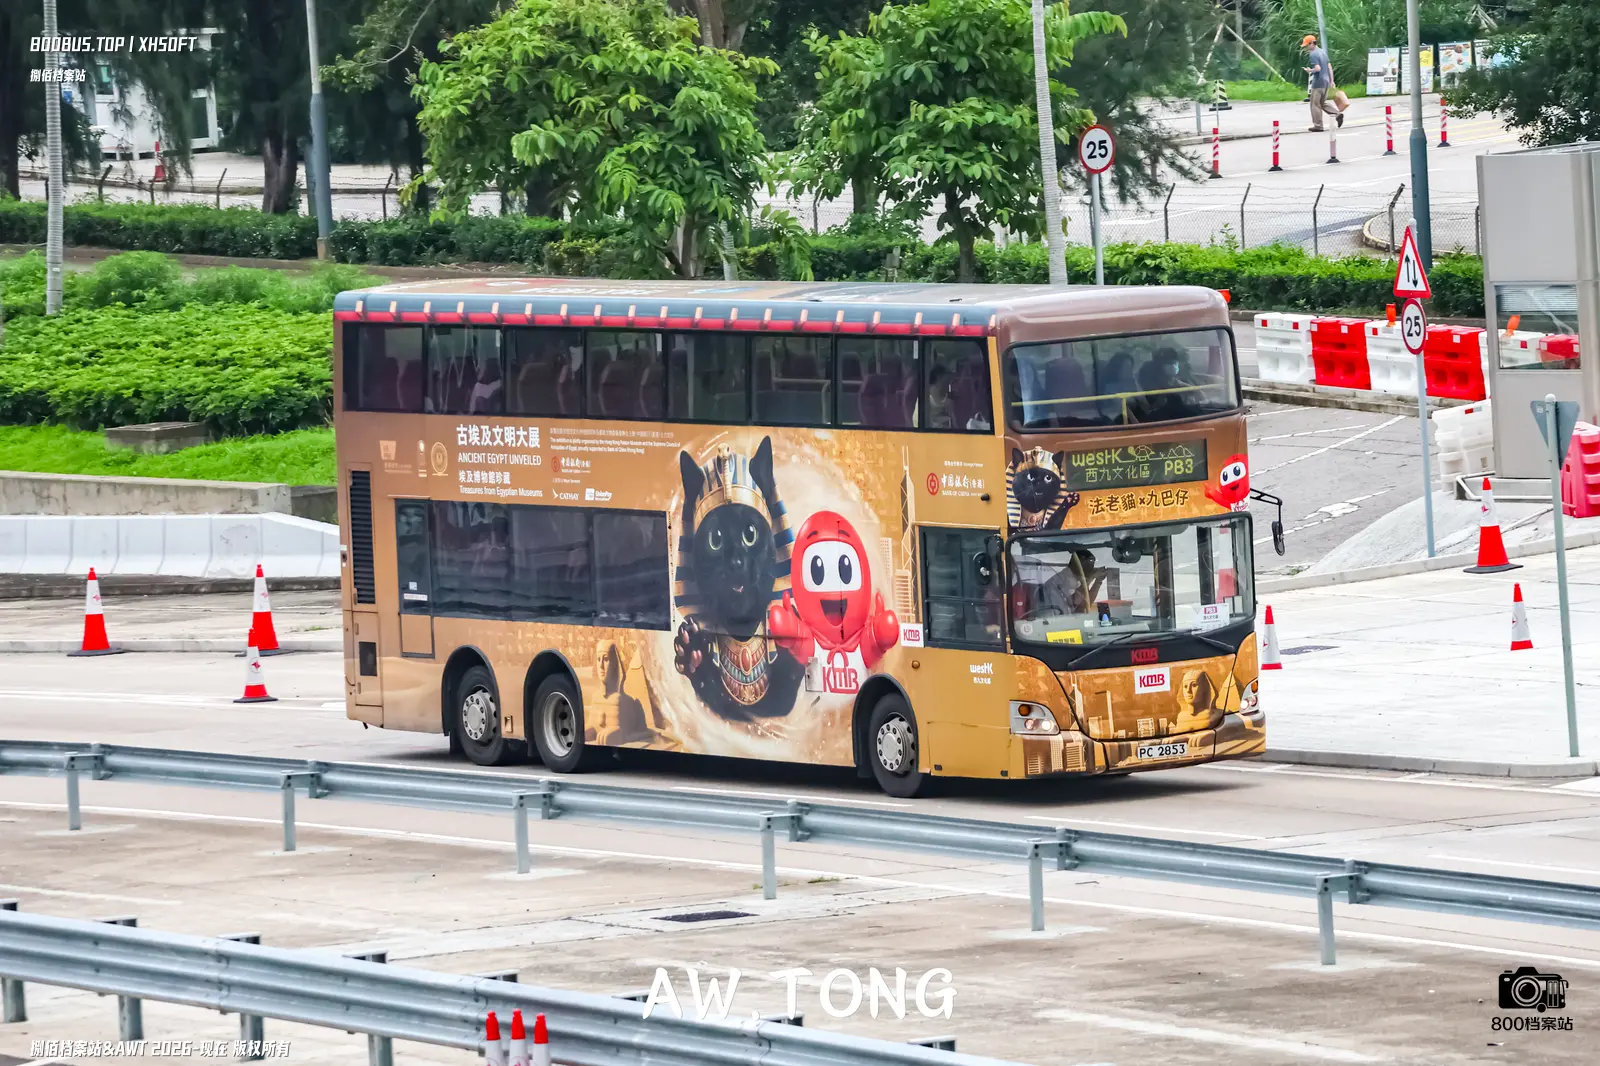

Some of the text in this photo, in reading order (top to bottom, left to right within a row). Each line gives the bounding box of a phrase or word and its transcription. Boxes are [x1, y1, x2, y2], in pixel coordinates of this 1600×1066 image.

[1086, 139, 1108, 160] 25
[1405, 315, 1421, 337] 25
[456, 423, 540, 448] 古埃及文明大展
[457, 452, 542, 466] ANCIENT EGYPT UNVEILED
[1085, 464, 1151, 483] 西九文化區
[1164, 459, 1194, 476] PB3
[459, 485, 484, 495] Treasures
[518, 488, 543, 497] Museums
[903, 629, 921, 642] KMB
[1131, 648, 1158, 663] KMB
[822, 666, 860, 695] KMB
[1139, 673, 1165, 688] KMB
[1139, 744, 1185, 757] PC 2853
